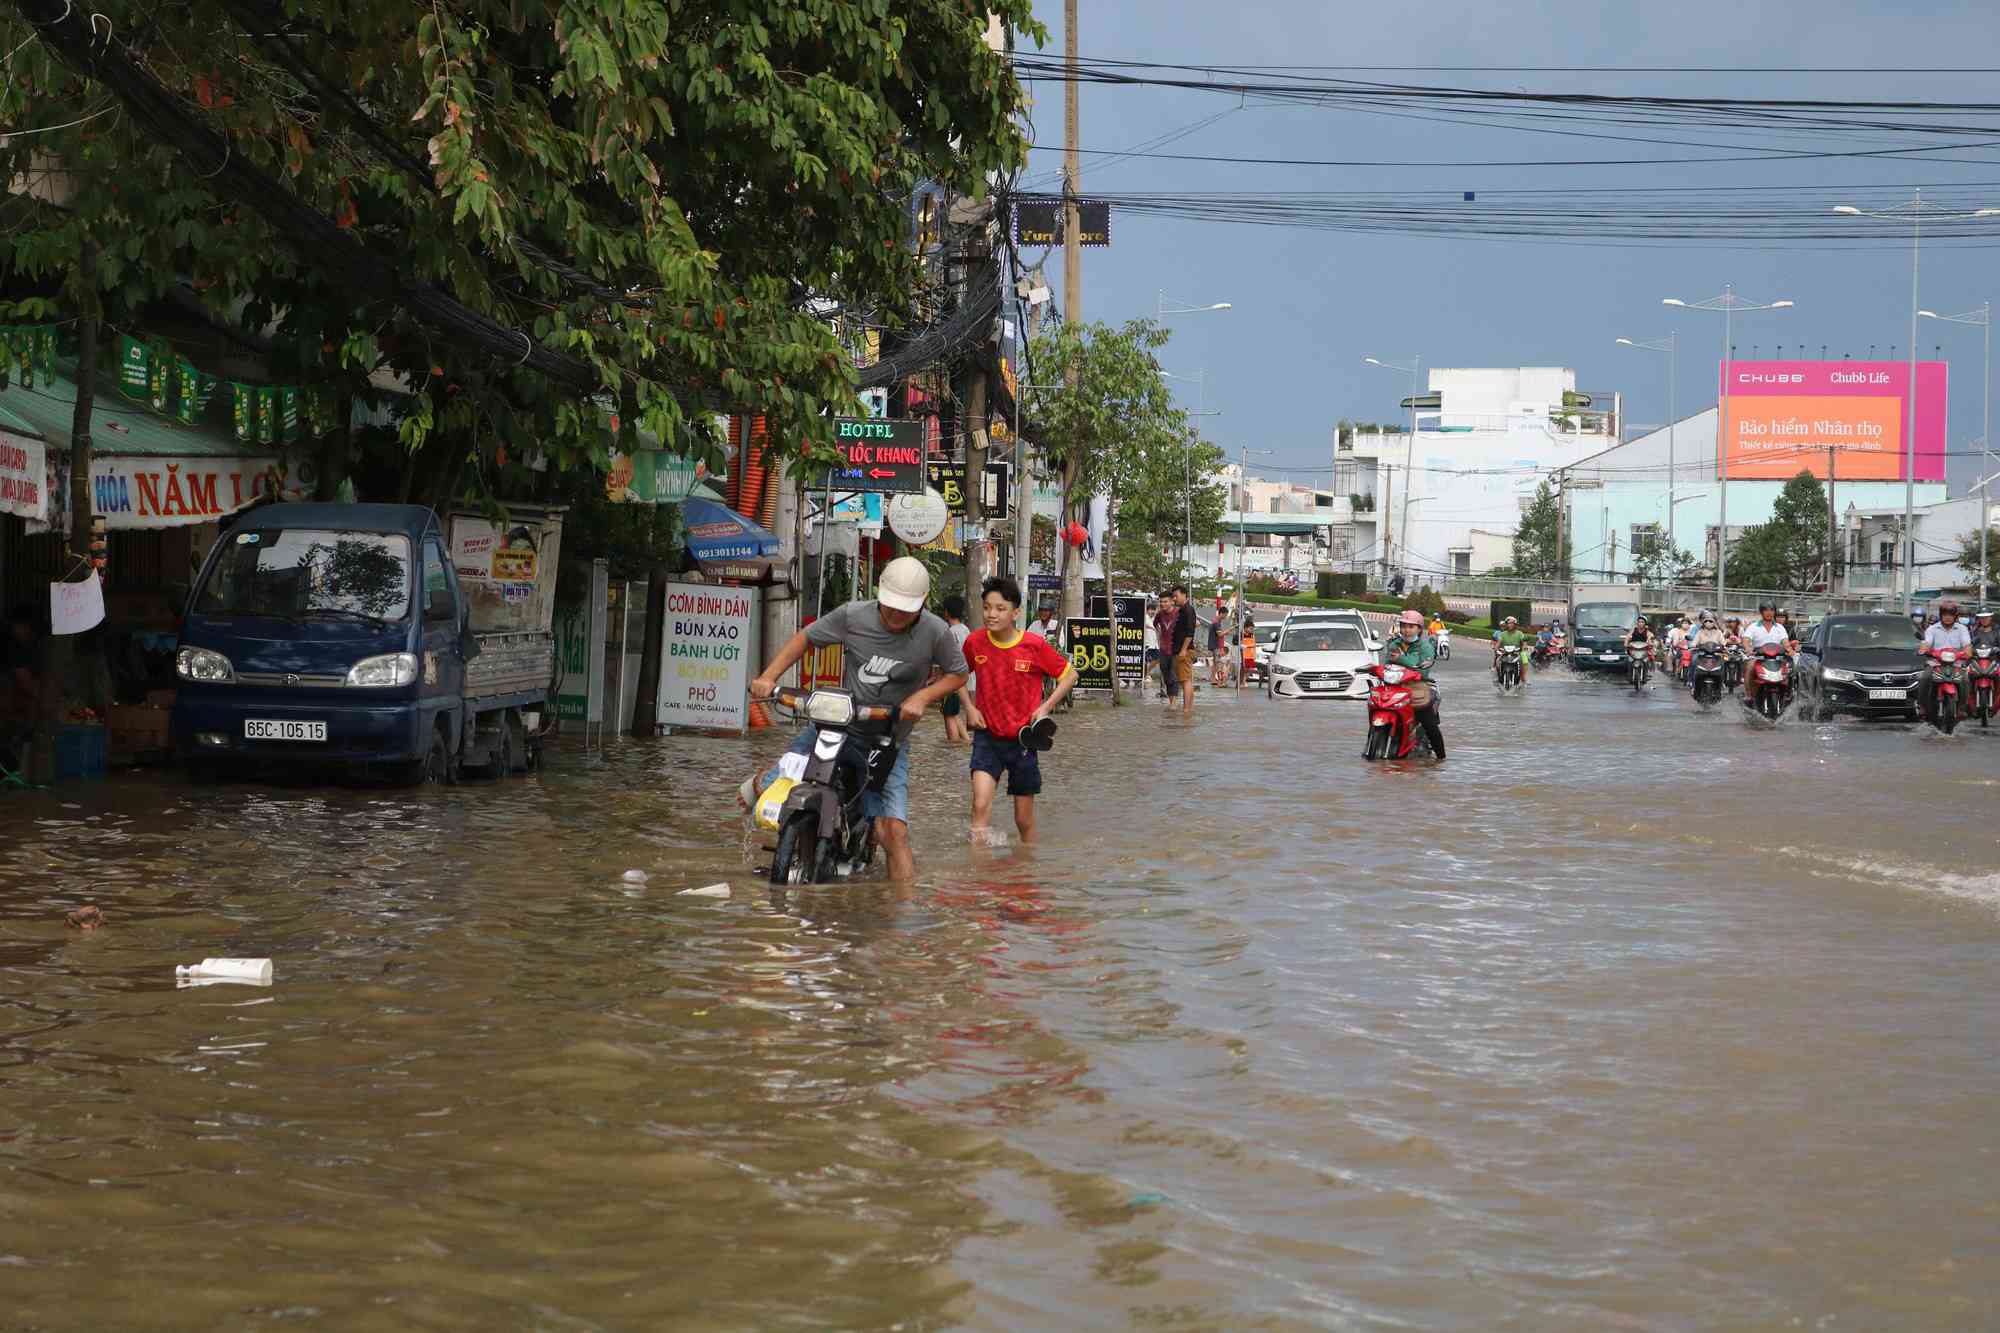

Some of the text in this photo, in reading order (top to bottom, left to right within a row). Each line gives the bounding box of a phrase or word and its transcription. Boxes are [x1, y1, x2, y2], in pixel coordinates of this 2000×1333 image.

[1739, 372, 1890, 384] CHUBB Chubb Life
[840, 423, 894, 438] HOTEL
[1739, 417, 1882, 439] Bảo hiểm Nhân thọ
[876, 448, 920, 464] KHANG
[95, 467, 132, 513] HÓA
[134, 463, 224, 516] NĂM
[698, 547, 753, 558] 0913011144
[668, 592, 694, 614] CƠM
[697, 592, 722, 615] BÌNH
[674, 619, 704, 637] BÚN
[1117, 625, 1143, 640] Store
[713, 643, 740, 661] ƯỚT
[1073, 644, 1110, 671] BB
[865, 655, 904, 674] NIK
[688, 683, 717, 702] PHỞ
[247, 721, 325, 739] 65C-105.15
